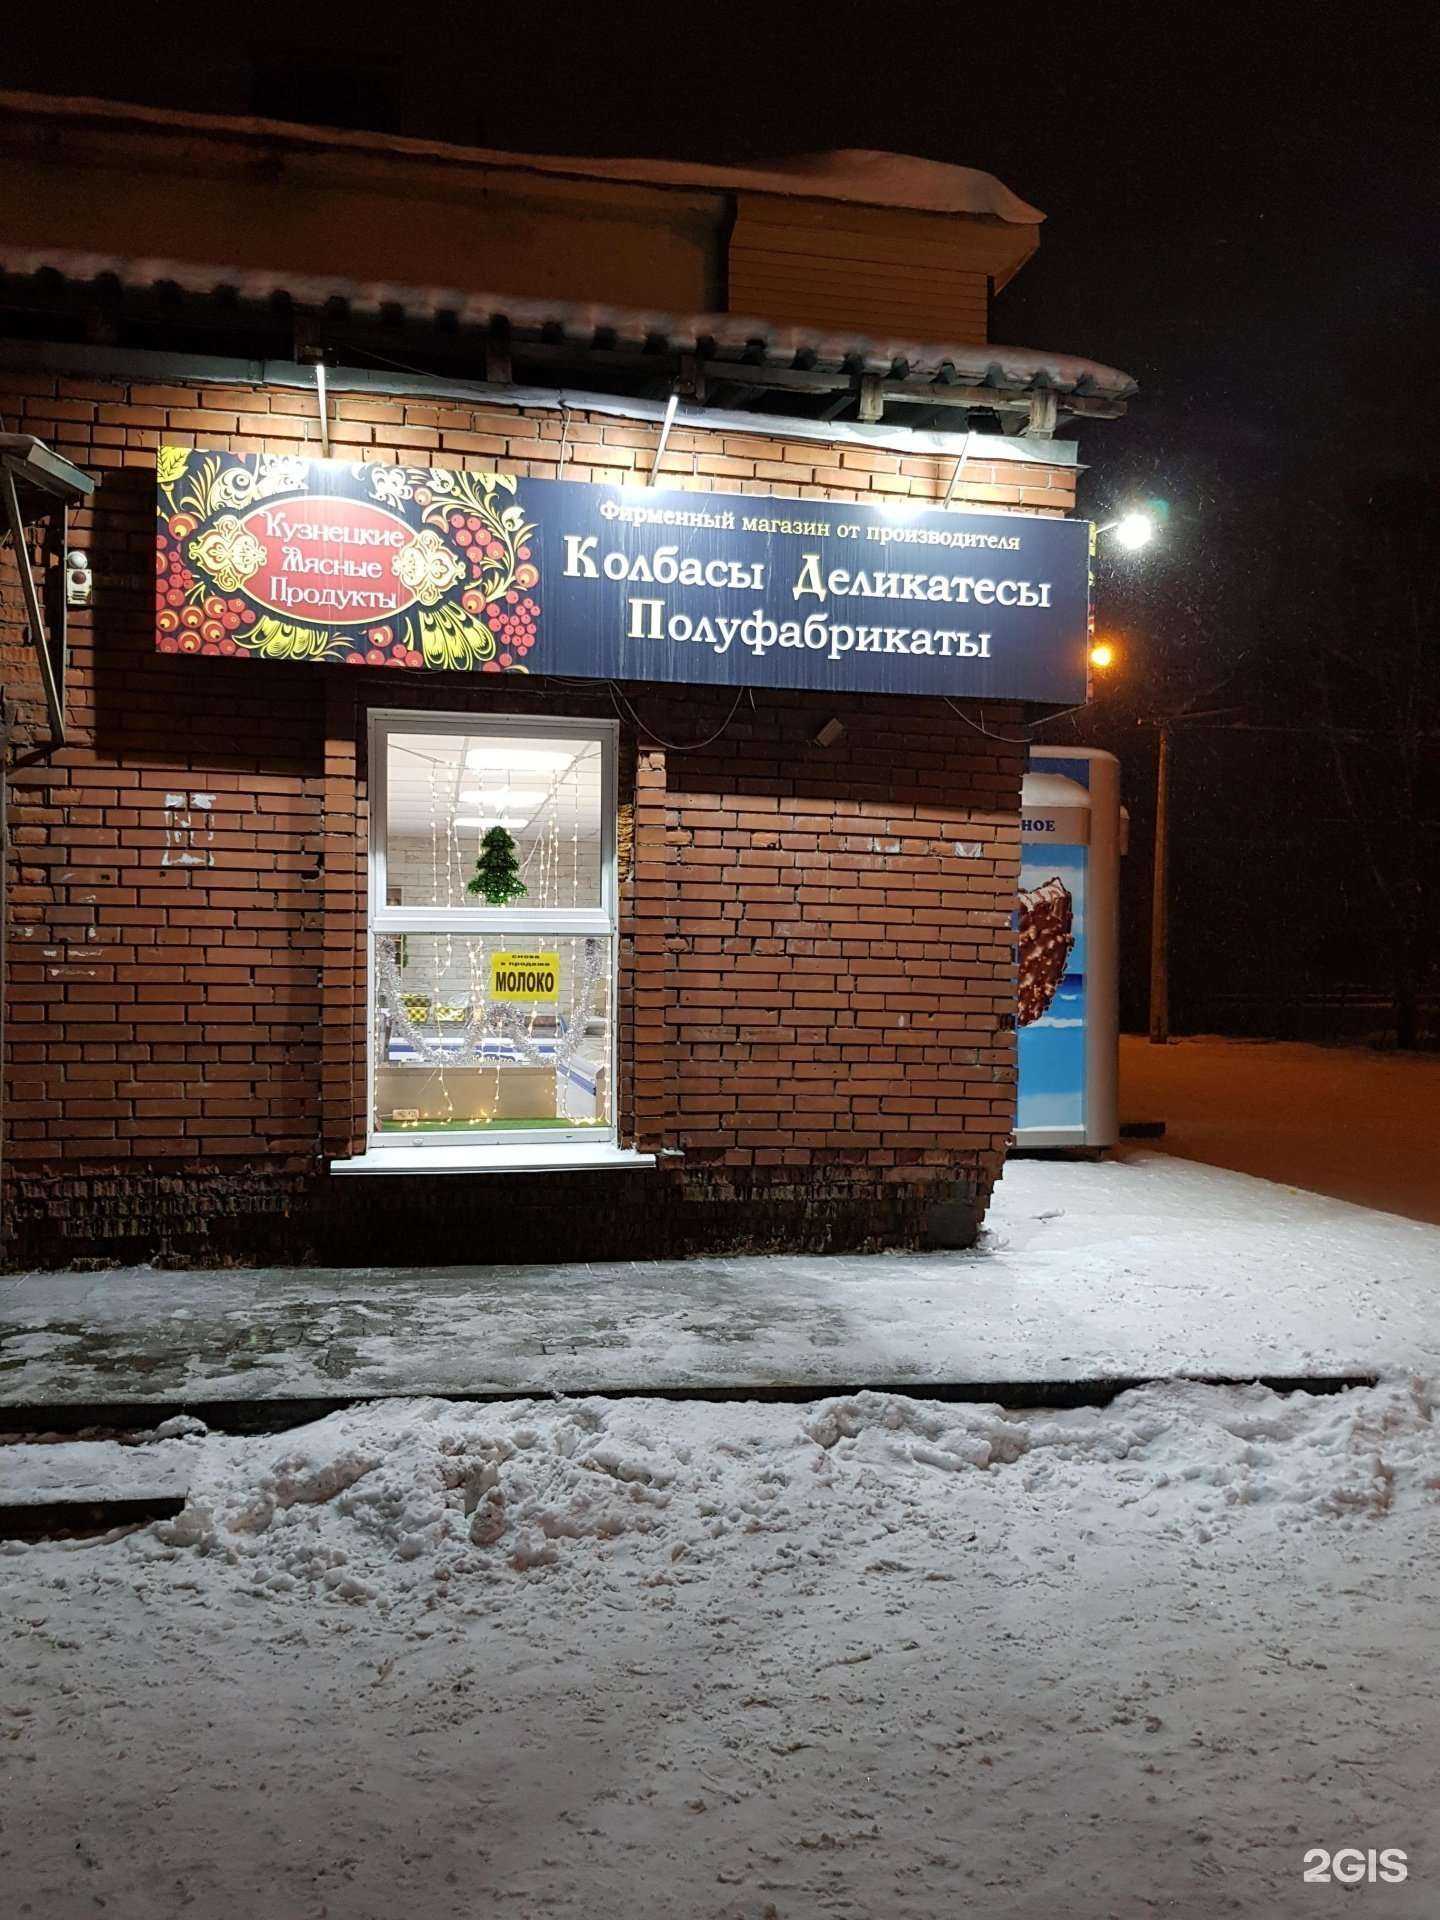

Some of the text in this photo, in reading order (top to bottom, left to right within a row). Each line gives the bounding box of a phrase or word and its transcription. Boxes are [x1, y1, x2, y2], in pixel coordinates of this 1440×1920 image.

[259, 511, 405, 548] Кузнецкие
[599, 499, 1021, 551] Фирменный магазин от производителя
[281, 546, 384, 579] Мясные
[563, 535, 1052, 608] Колбасы Деликатесы
[270, 576, 398, 610] Продукты
[627, 597, 992, 661] Полуфабрикаты
[495, 971, 554, 993] МОЛОКО
